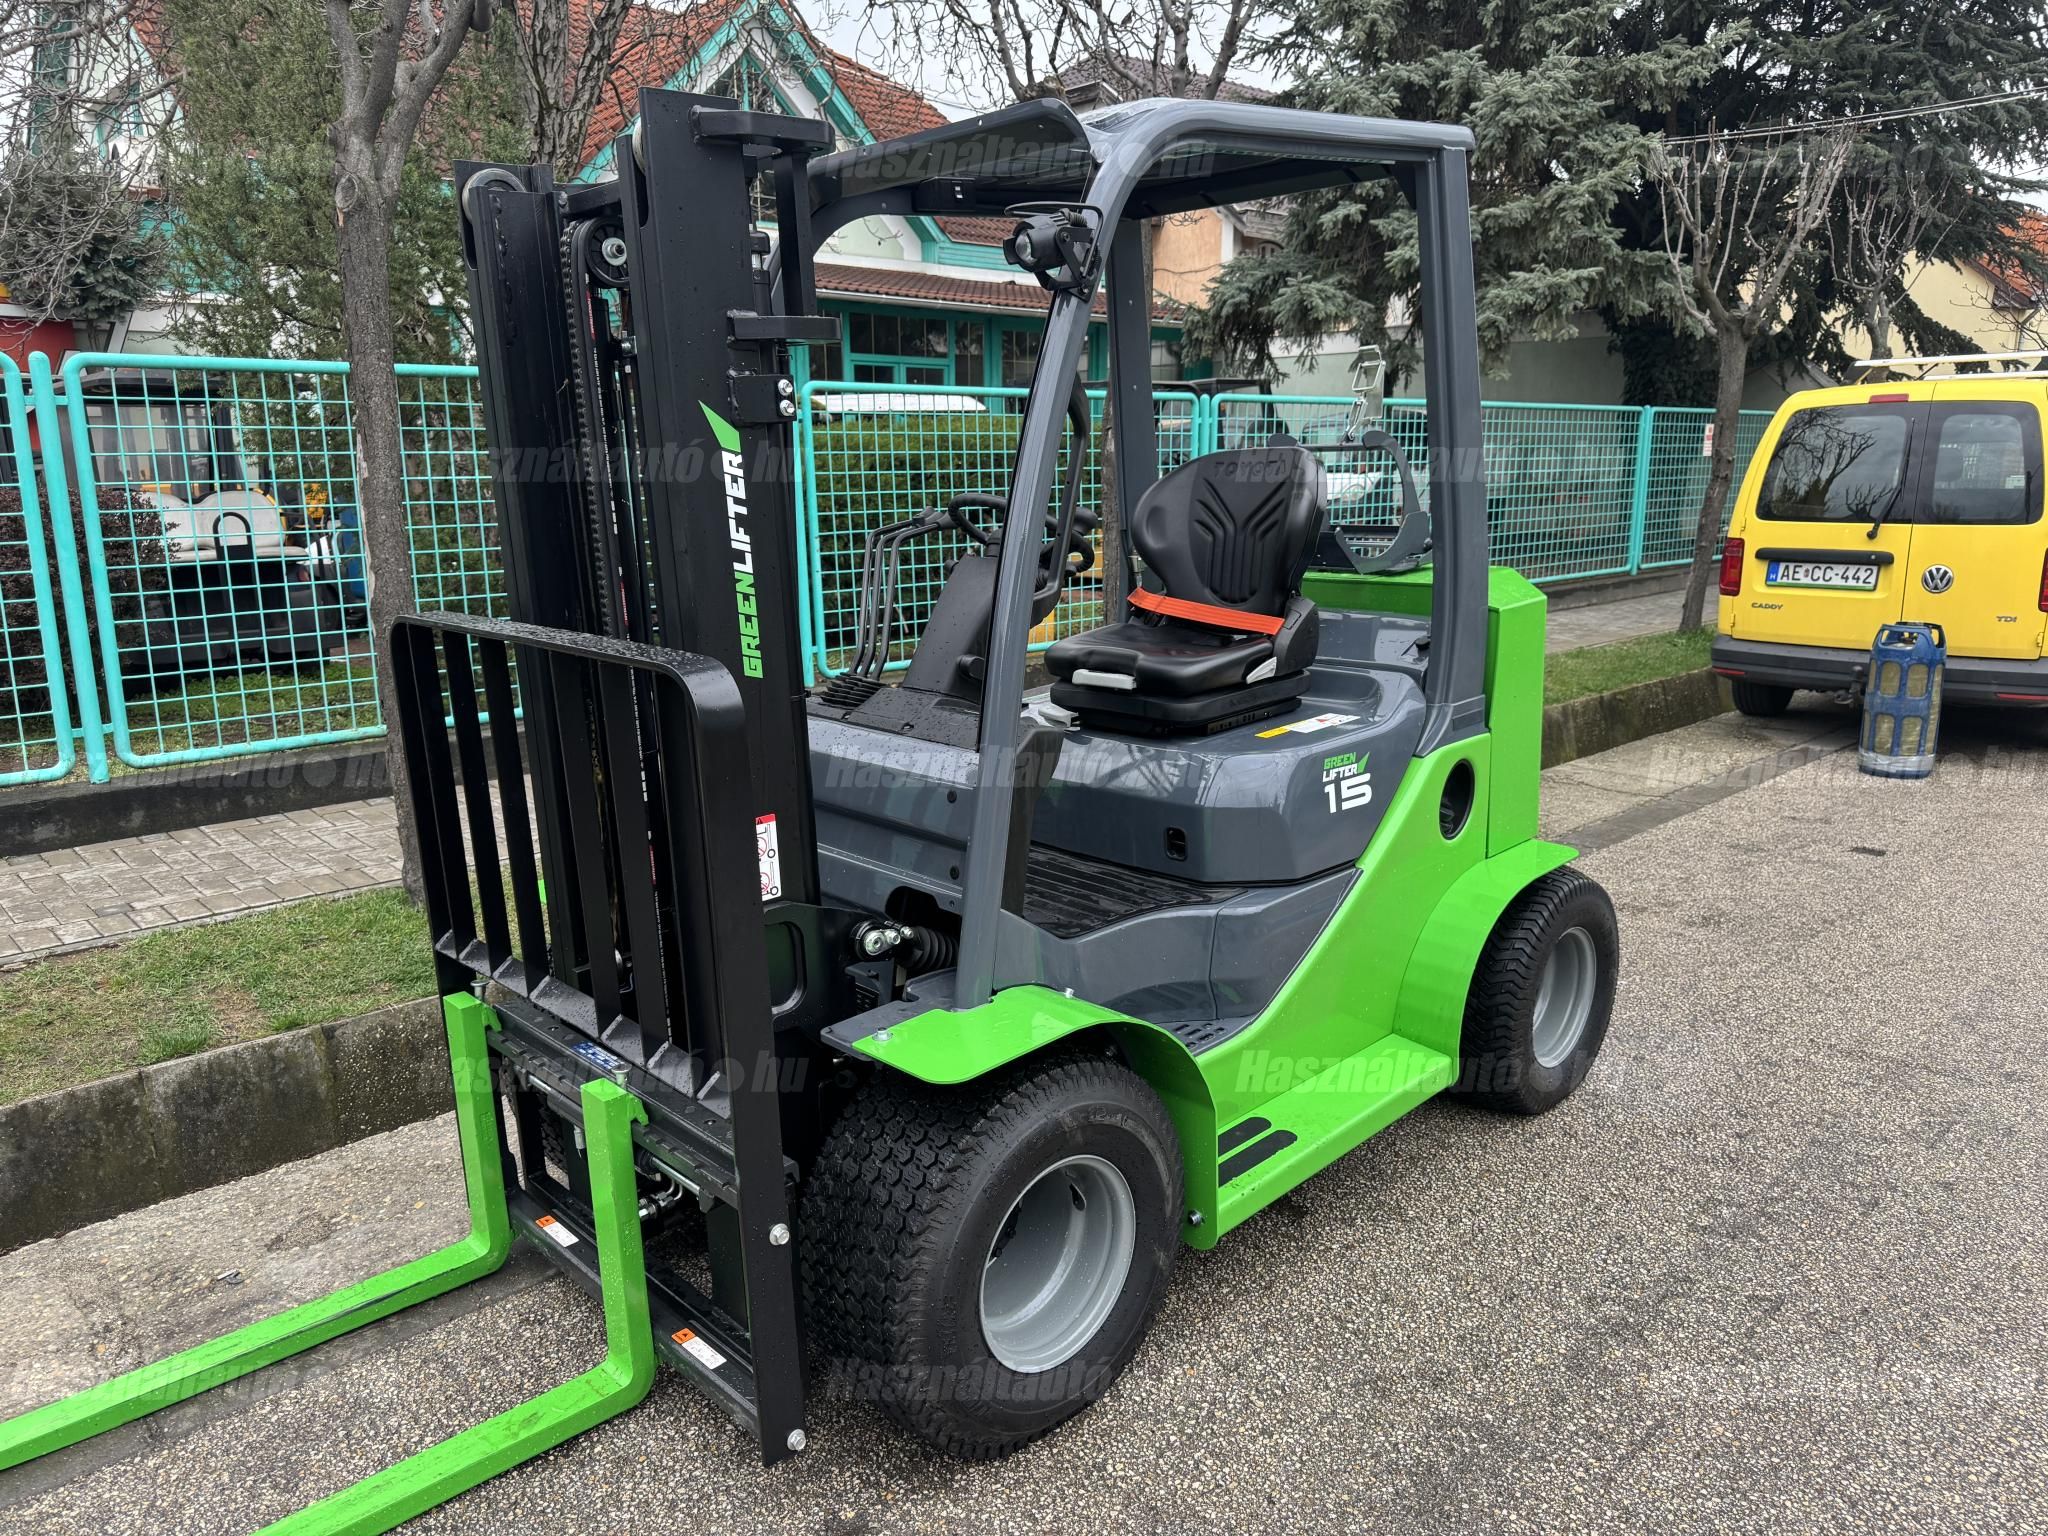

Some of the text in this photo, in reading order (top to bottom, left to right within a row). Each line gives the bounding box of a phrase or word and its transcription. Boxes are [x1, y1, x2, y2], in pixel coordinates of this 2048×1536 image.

[721, 450, 764, 679] GREENLIFTER
[1780, 564, 1803, 581] AE
[1810, 565, 1874, 585] CC-442
[1751, 602, 1783, 610] CADDY
[1323, 751, 1357, 770] GREEN
[1322, 763, 1358, 782] LIFTER
[1324, 772, 1373, 814] 15
